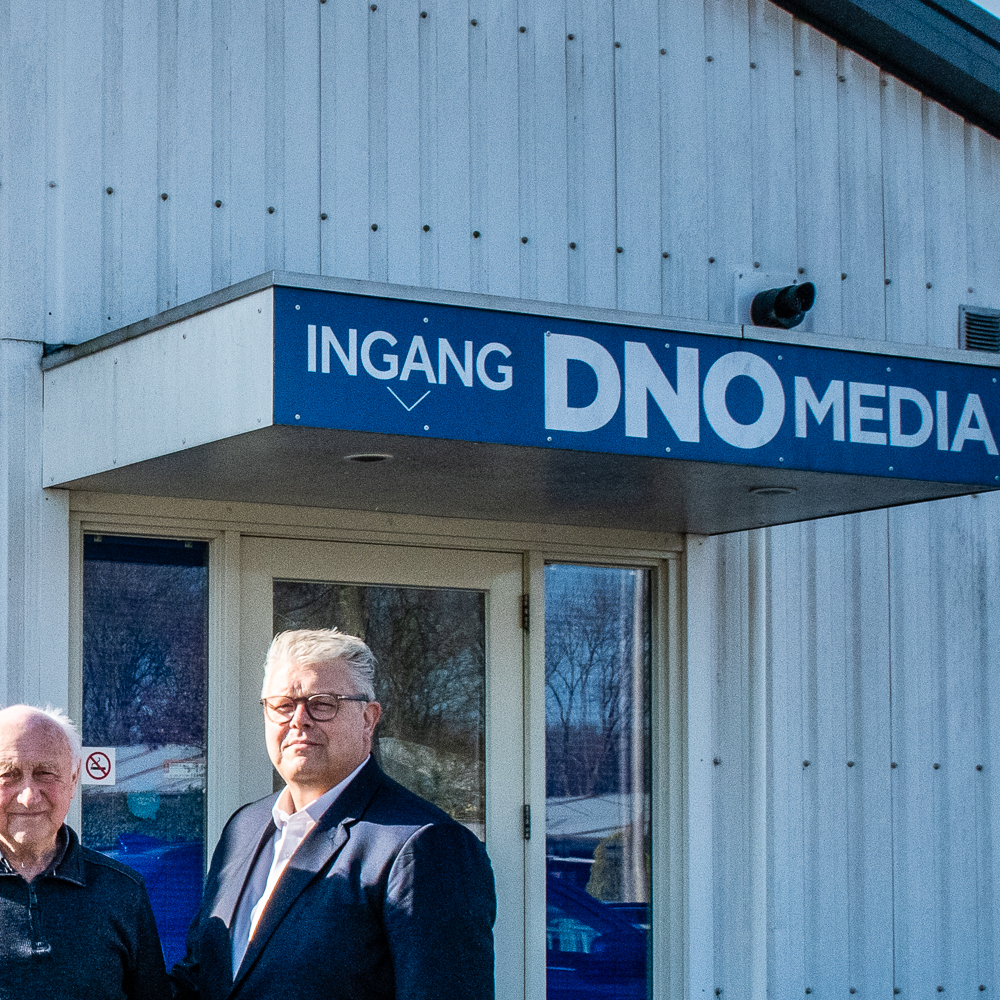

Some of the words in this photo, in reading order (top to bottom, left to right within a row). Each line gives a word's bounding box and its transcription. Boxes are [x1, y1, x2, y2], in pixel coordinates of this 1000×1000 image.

[307, 324, 513, 391] INGANG
[543, 332, 786, 449] DNO
[794, 375, 999, 456] MEDIA
